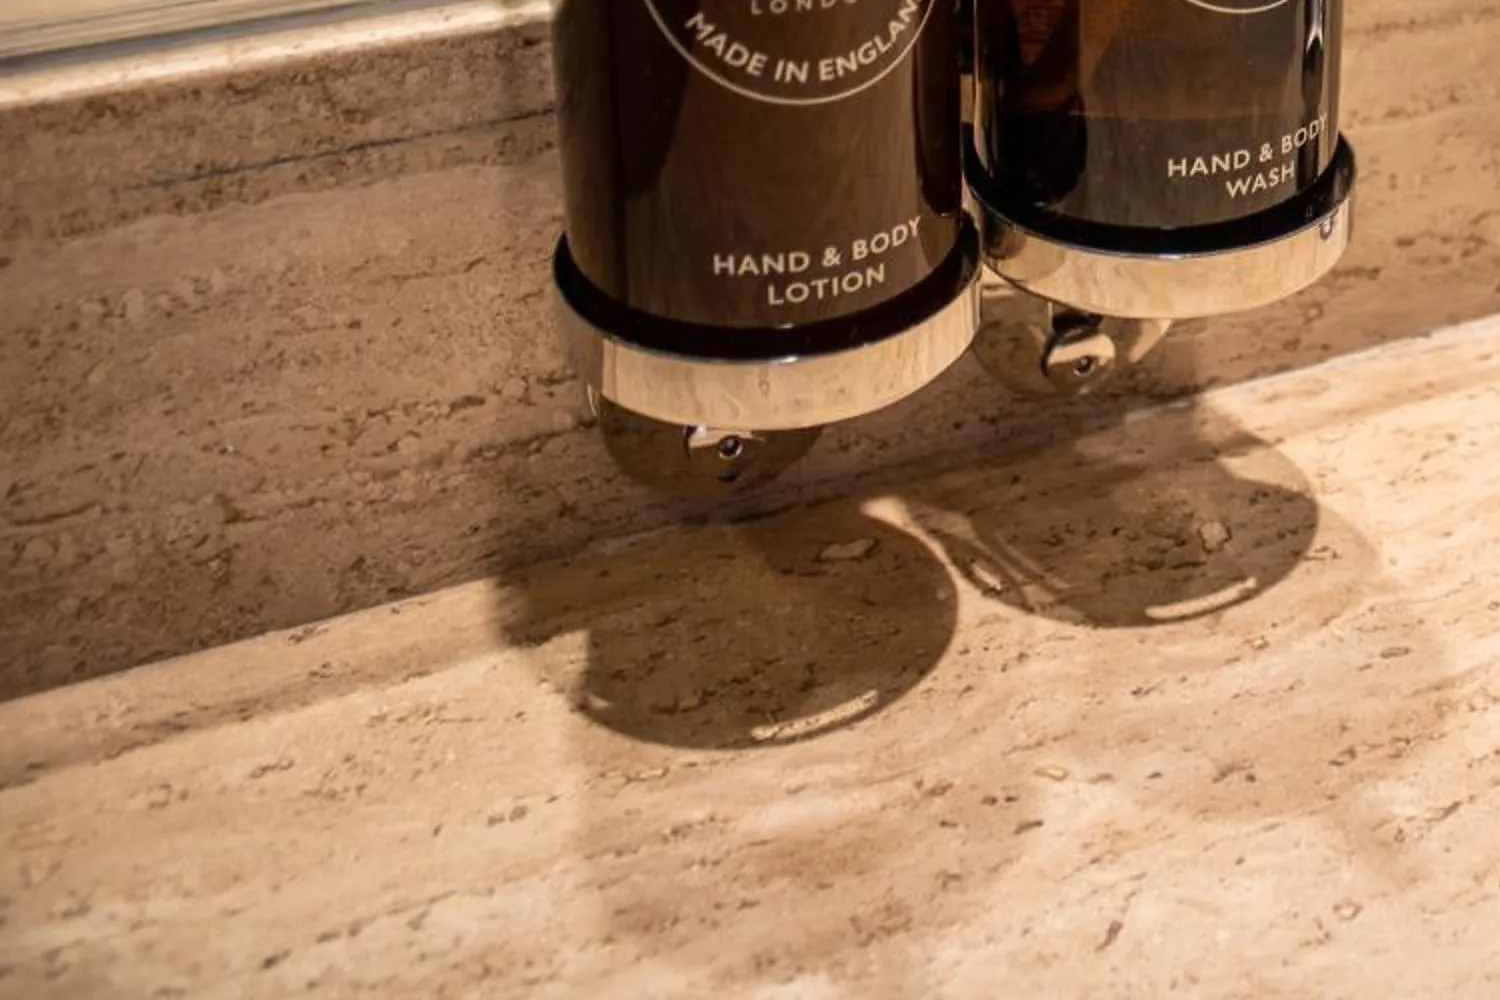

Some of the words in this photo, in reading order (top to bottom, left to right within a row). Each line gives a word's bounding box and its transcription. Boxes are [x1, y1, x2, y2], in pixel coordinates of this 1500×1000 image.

[685, 11, 767, 77] MADE
[774, 59, 809, 83] IN
[1167, 149, 1250, 178] HAND
[1259, 142, 1274, 163] &
[1281, 112, 1327, 155] BODY
[1226, 160, 1295, 199] WASH
[713, 251, 811, 276] HAND
[822, 246, 841, 268] &
[852, 216, 921, 261] BODY
[768, 263, 886, 306] LOTION
